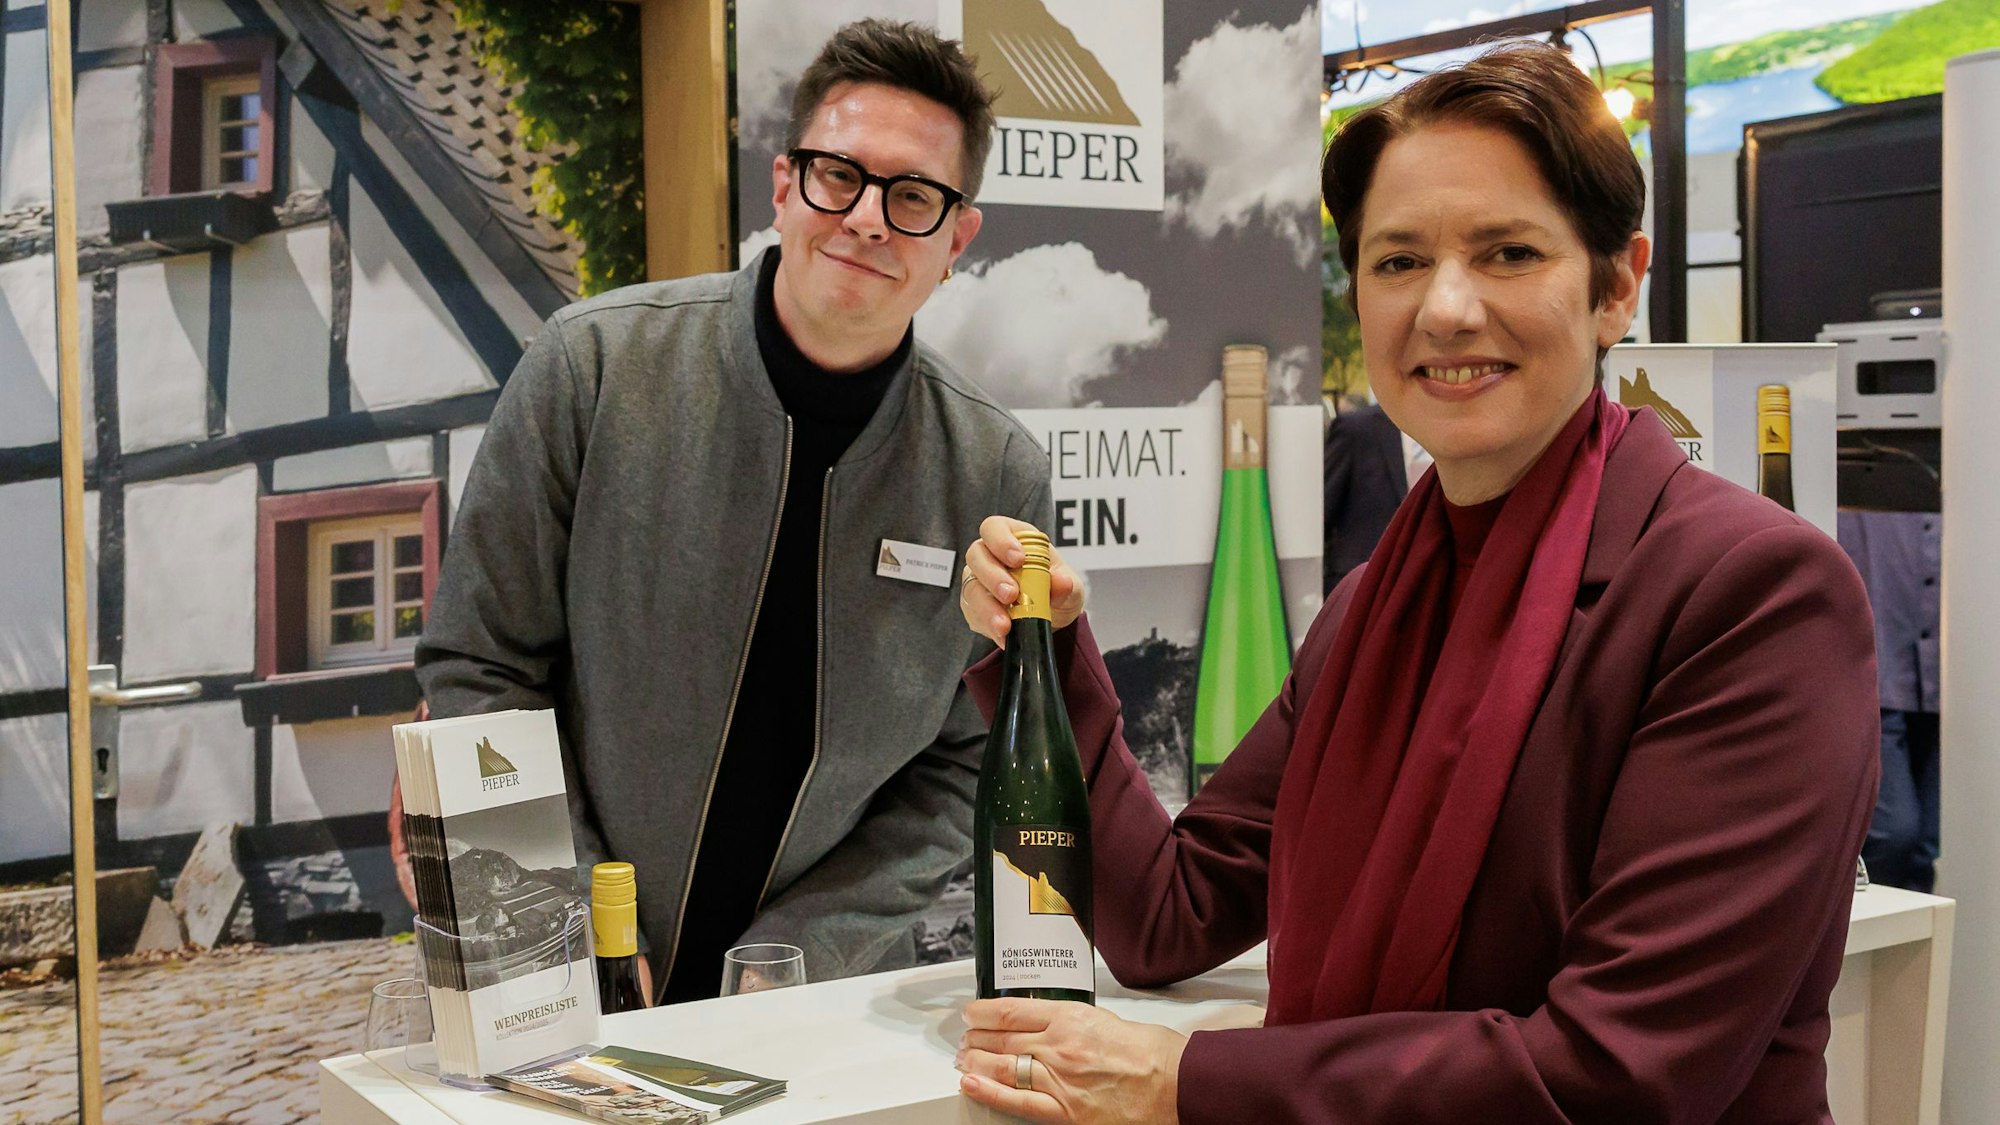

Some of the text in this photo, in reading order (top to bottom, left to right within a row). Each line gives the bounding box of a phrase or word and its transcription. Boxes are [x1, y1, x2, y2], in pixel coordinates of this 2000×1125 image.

[997, 127, 1142, 184] IEPER
[1055, 498, 1138, 547] EIN.
[481, 773, 520, 792] PIEPER
[1019, 830, 1076, 848] PIEPER
[1002, 947, 1074, 958] KÖNIGSWINTERER
[1002, 958, 1078, 969] GRÜNER VELTLINER
[494, 996, 578, 1031] WEINPREISLISTE
